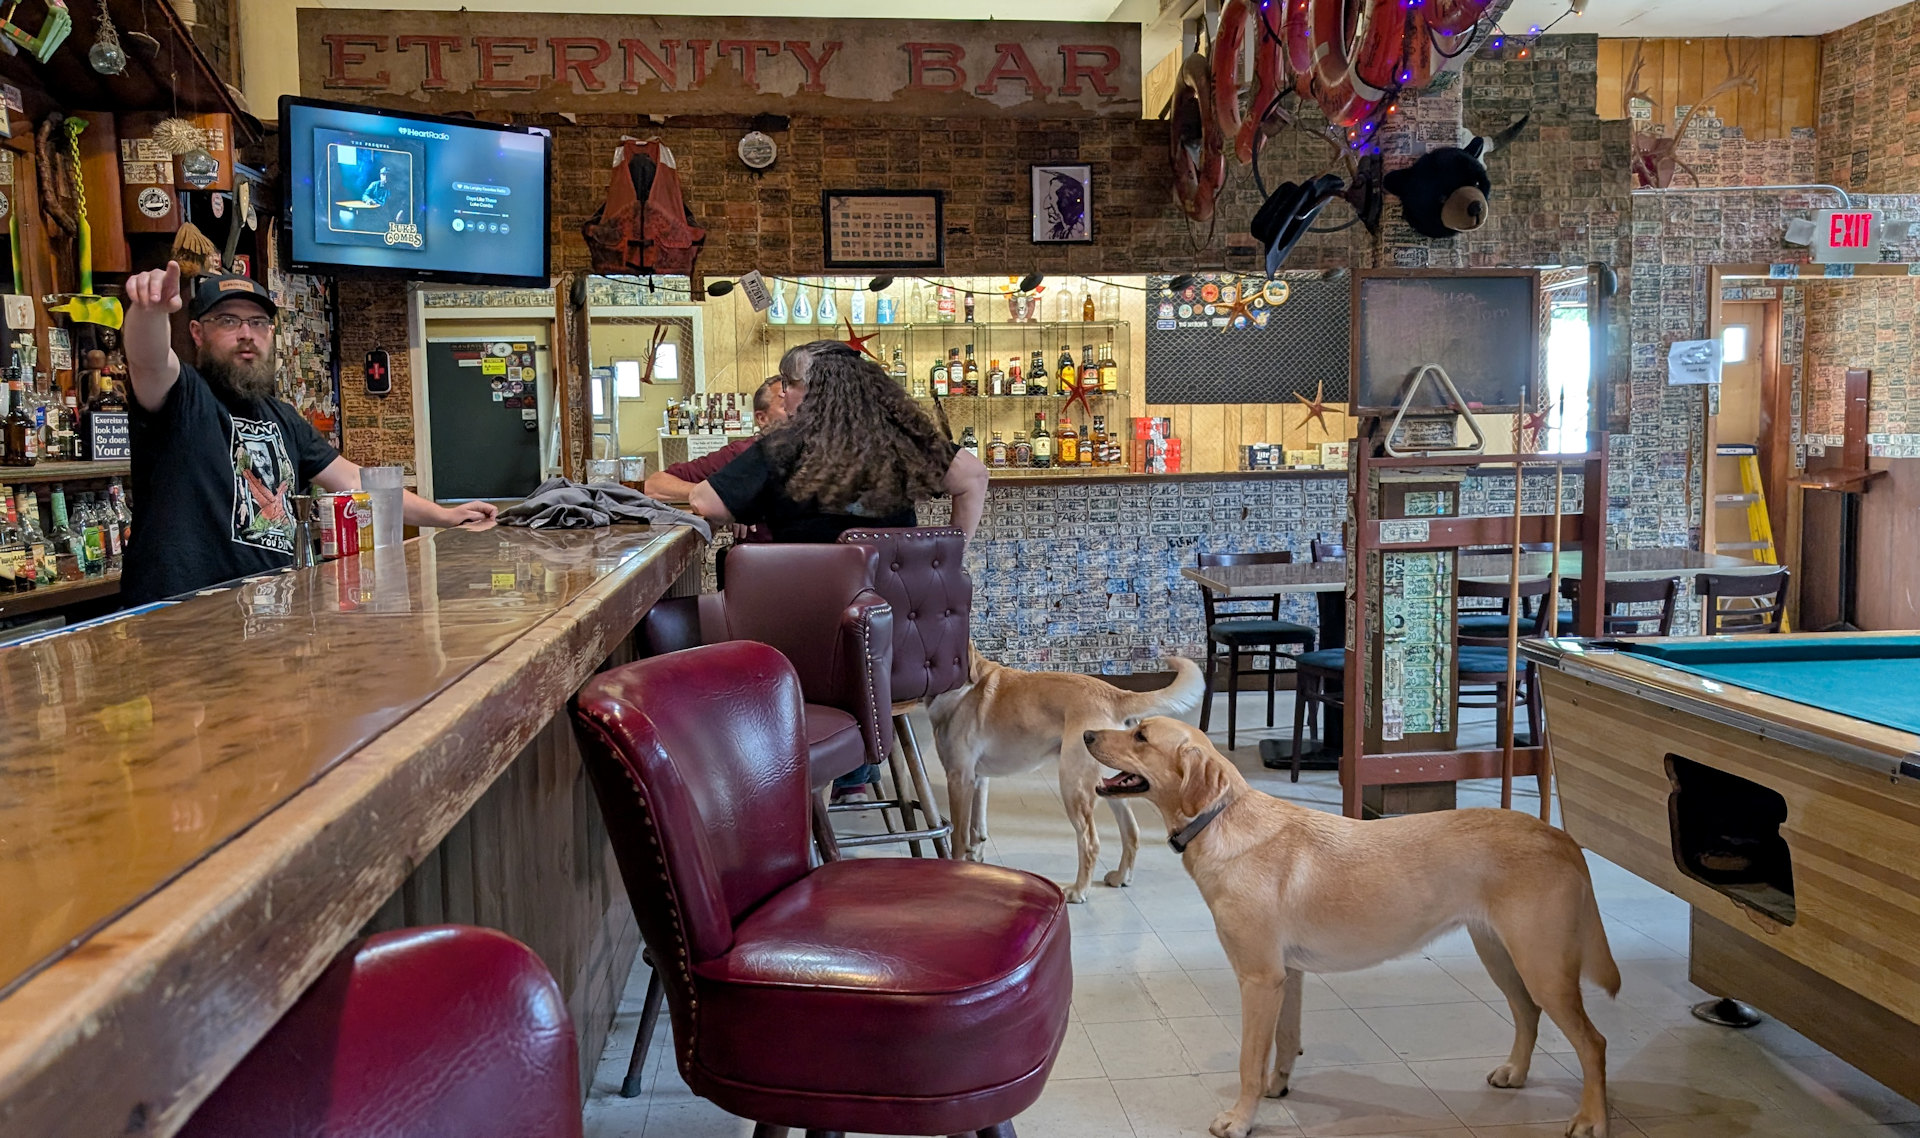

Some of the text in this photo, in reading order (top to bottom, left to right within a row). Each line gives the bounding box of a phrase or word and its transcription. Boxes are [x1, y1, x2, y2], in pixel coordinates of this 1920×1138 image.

[322, 34, 1121, 96] ETERNITY BAR
[389, 222, 417, 234] LUKE
[1829, 213, 1873, 248] EXIT
[384, 232, 422, 247] COMBS
[95, 416, 123, 424] Exercise
[95, 425, 129, 434] look bett
[96, 435, 127, 444] So does
[95, 444, 122, 456] Your
[1057, 512, 1087, 522] FARGO
[260, 536, 277, 548] YOU
